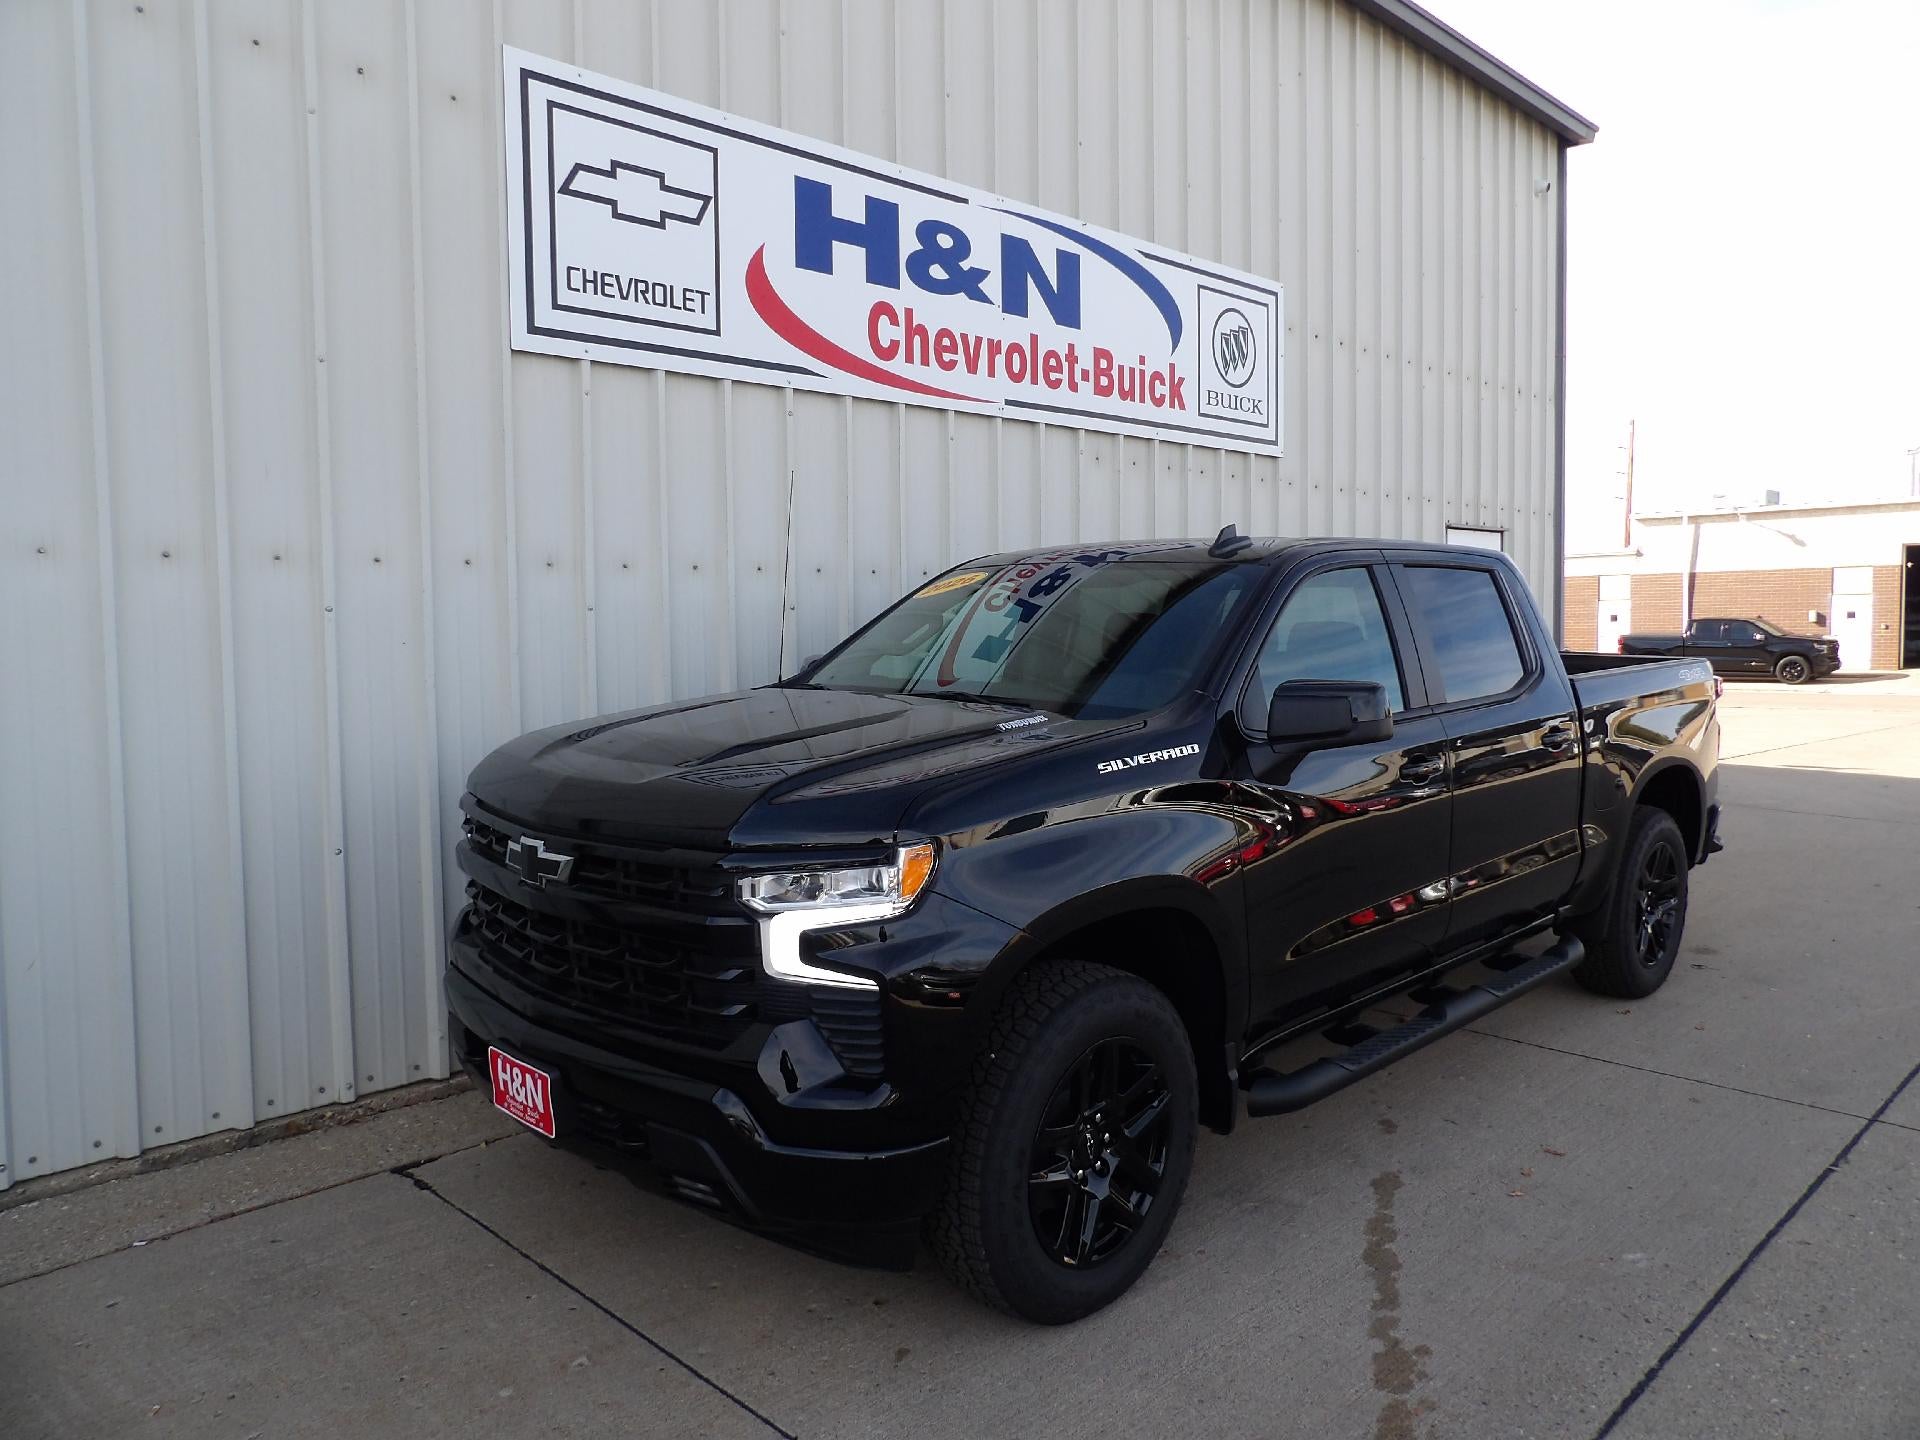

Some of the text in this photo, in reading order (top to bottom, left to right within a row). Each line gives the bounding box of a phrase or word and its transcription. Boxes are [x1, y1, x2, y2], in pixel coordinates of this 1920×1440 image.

[794, 175, 1081, 330] H&N
[566, 265, 711, 315] CHEVROLET
[867, 300, 1187, 411] Chevrolet-Buick
[1205, 389, 1264, 415] BUICK
[1097, 743, 1201, 775] SILVERADO
[497, 1057, 545, 1114] H&N
